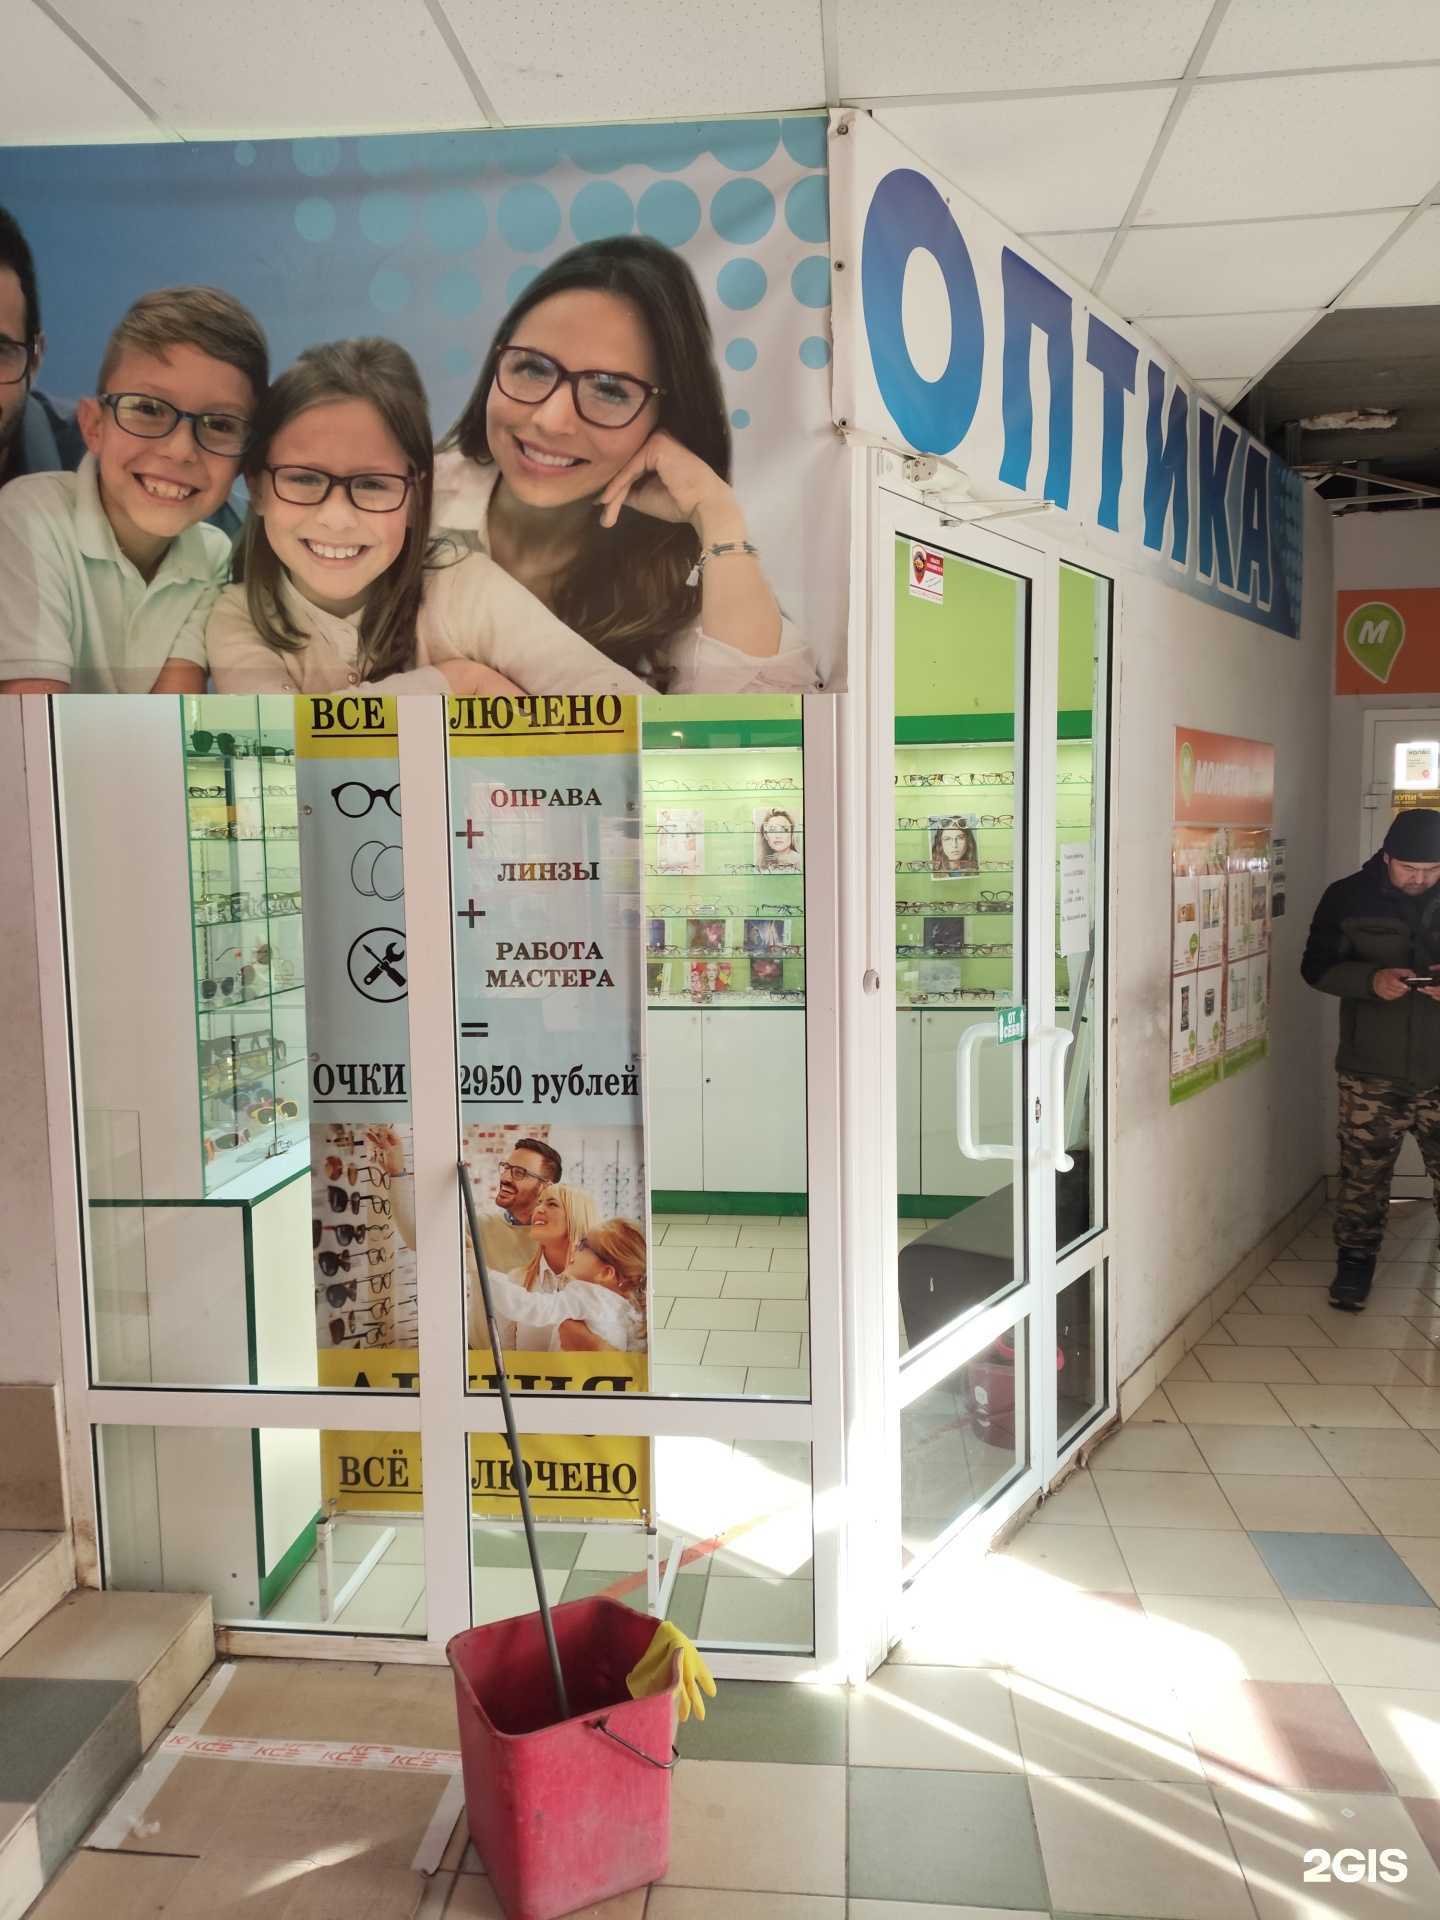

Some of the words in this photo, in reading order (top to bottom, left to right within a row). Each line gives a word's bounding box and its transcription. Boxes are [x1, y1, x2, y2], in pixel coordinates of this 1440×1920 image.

[861, 167, 1271, 612] ОПТИКА
[311, 697, 385, 730] ВСЕ
[450, 694, 622, 730] ЛЮЧЕНО
[490, 787, 602, 808] ОПРАВА
[497, 861, 600, 883] ЛИНЗЫ
[495, 941, 604, 961] РАБОТА
[485, 968, 615, 988] МАСТЕРА
[313, 1063, 406, 1096] ОЧКИ
[460, 1064, 522, 1096] 2950
[531, 1064, 640, 1104] рублей
[338, 1449, 409, 1488] ВСЁ
[471, 1459, 637, 1495] ЛЮЧЕНО
